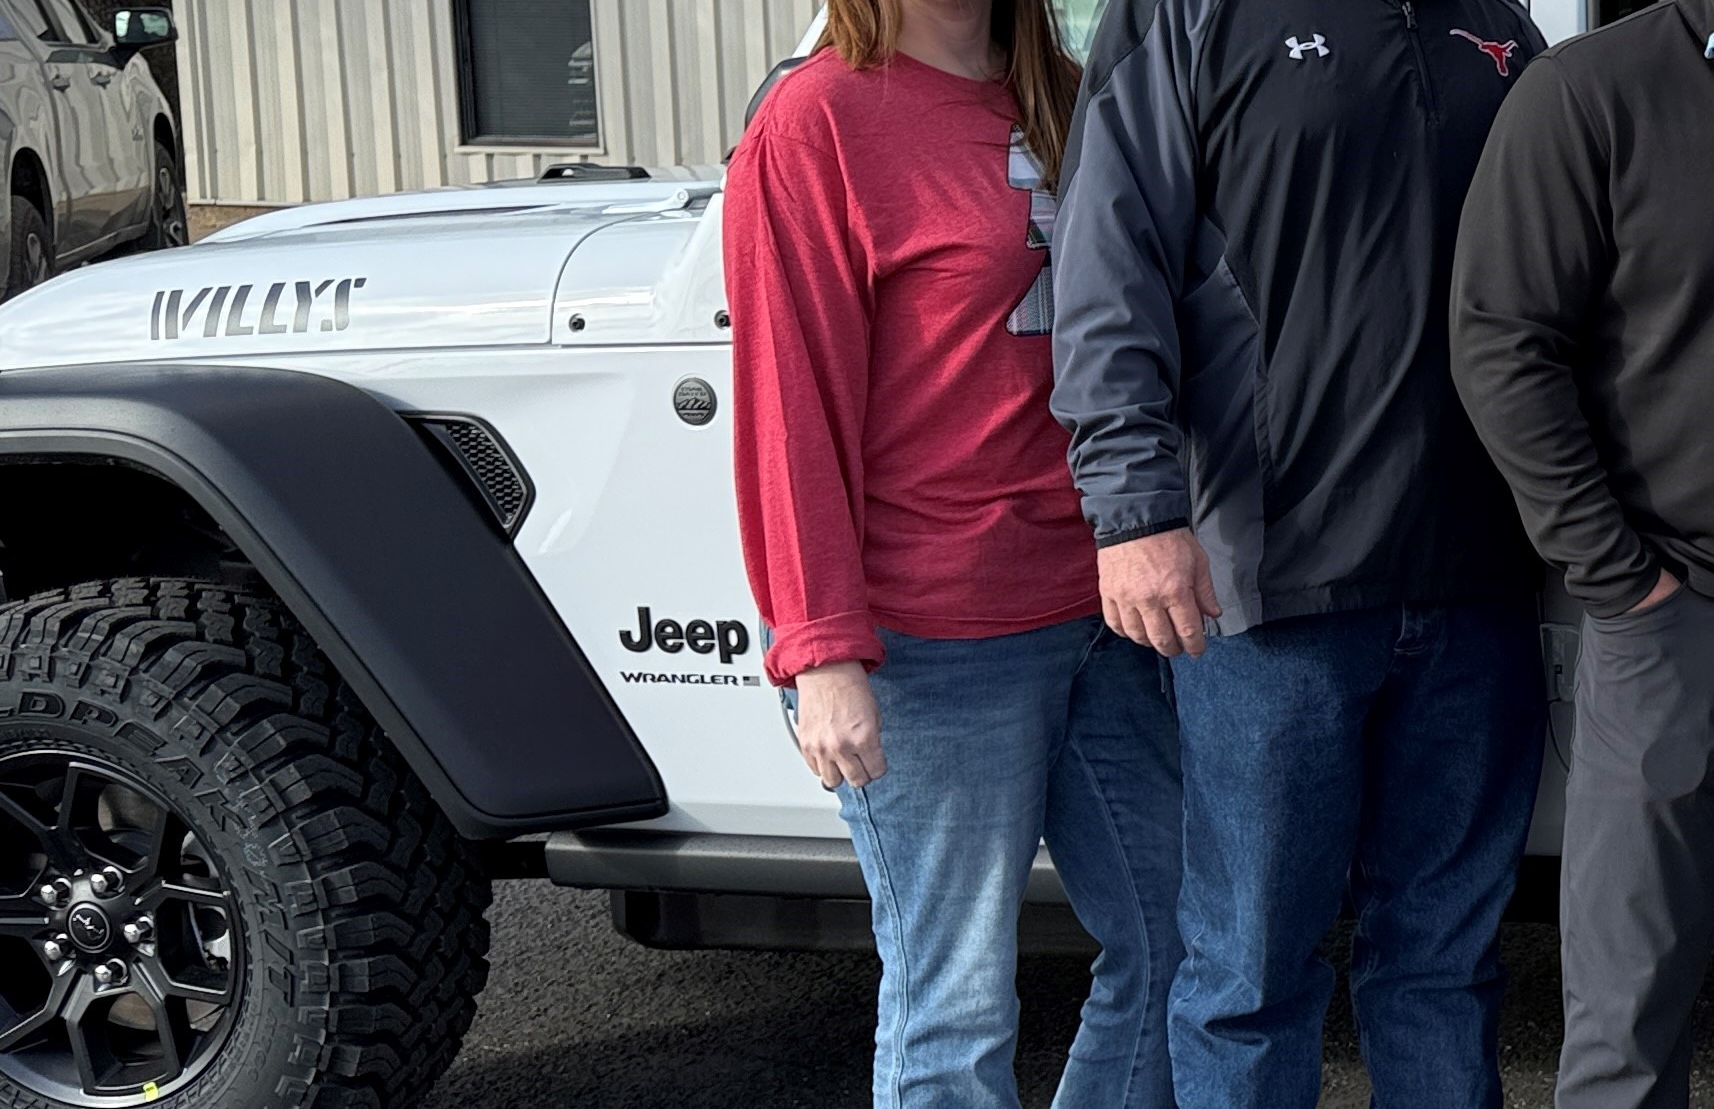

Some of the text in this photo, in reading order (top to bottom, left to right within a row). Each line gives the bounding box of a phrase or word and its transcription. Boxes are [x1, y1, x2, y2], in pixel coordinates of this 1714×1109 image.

[150, 277, 368, 341] WILLYS
[618, 606, 750, 665] Jeep
[619, 670, 740, 687] WRANGLER
